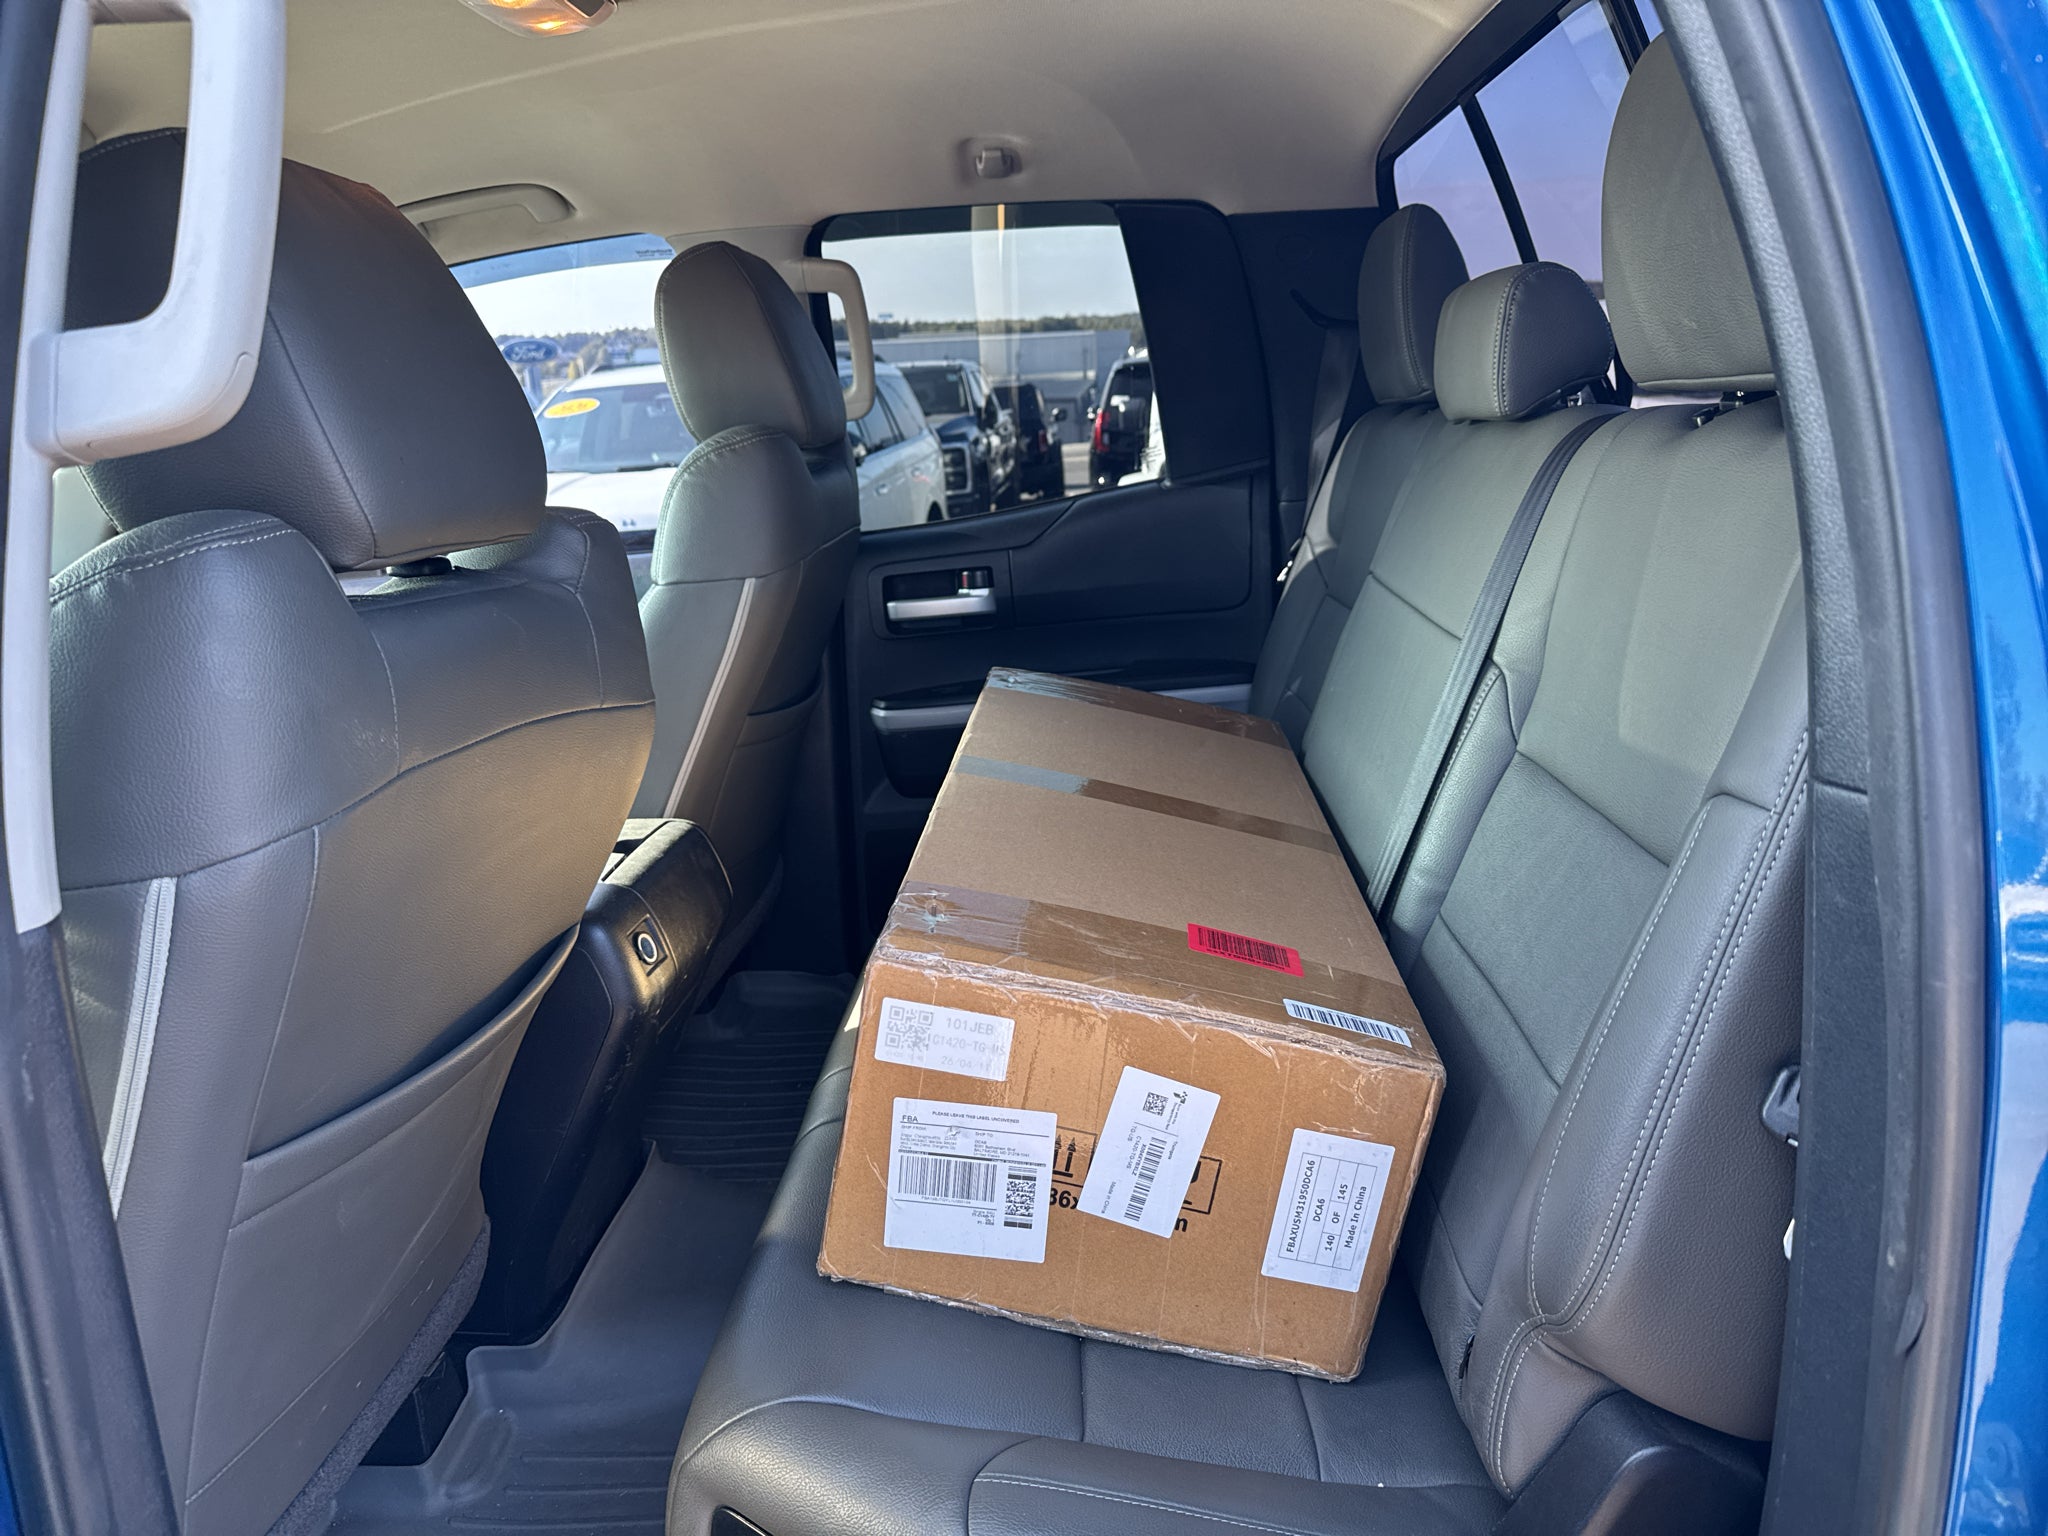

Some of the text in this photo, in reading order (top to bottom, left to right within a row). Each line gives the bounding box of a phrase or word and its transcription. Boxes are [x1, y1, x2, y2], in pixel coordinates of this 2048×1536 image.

[511, 344, 545, 360] Ford
[946, 1017, 994, 1036] 101JEB
[902, 1114, 918, 1122] FBA
[1286, 1160, 1315, 1253] FBAXUSM31950DCA6
[1313, 1198, 1326, 1222] DCA6
[1325, 1183, 1348, 1251] 140 OF 145
[1344, 1186, 1367, 1248] Made In China
